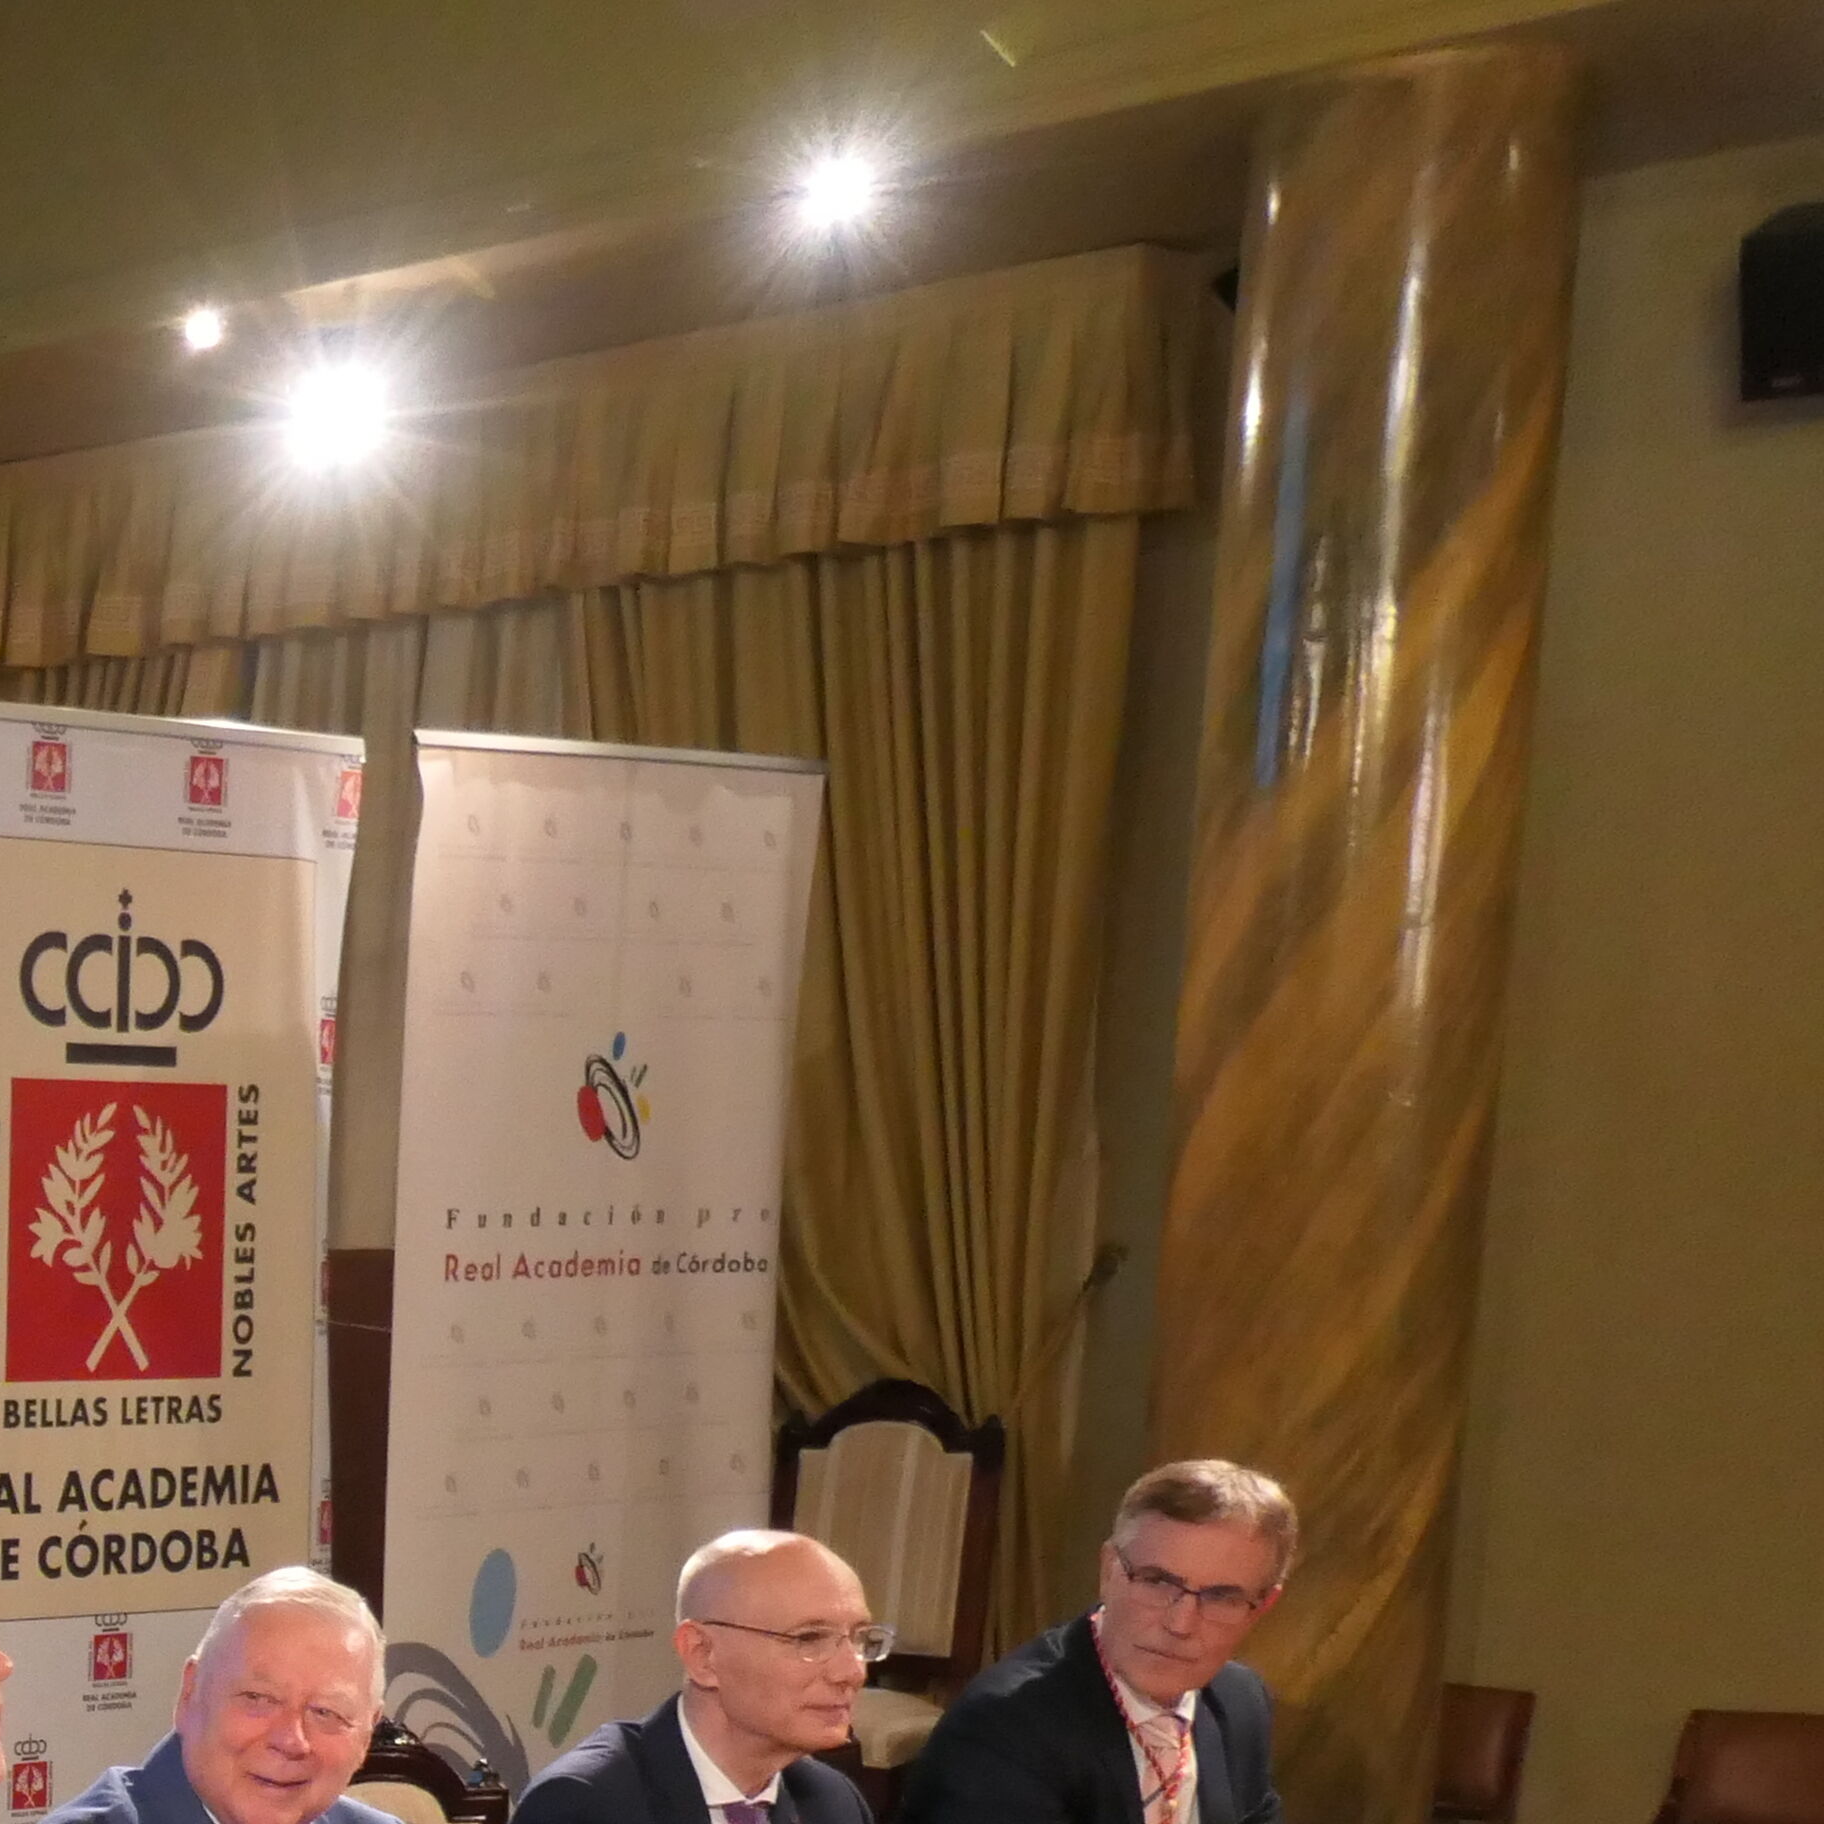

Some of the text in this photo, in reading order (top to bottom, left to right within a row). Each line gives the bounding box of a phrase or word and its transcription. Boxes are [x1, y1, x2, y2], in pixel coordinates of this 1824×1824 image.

[232, 1083, 260, 1378] NOBLES ARTES
[445, 1204, 666, 1231] Fundación
[444, 1249, 769, 1284] Real Academia de Córdoba
[3, 1394, 223, 1430] BELLAS LETRAS
[57, 1463, 280, 1513] ACADEMIA
[38, 1519, 251, 1580] CÓRDOBA
